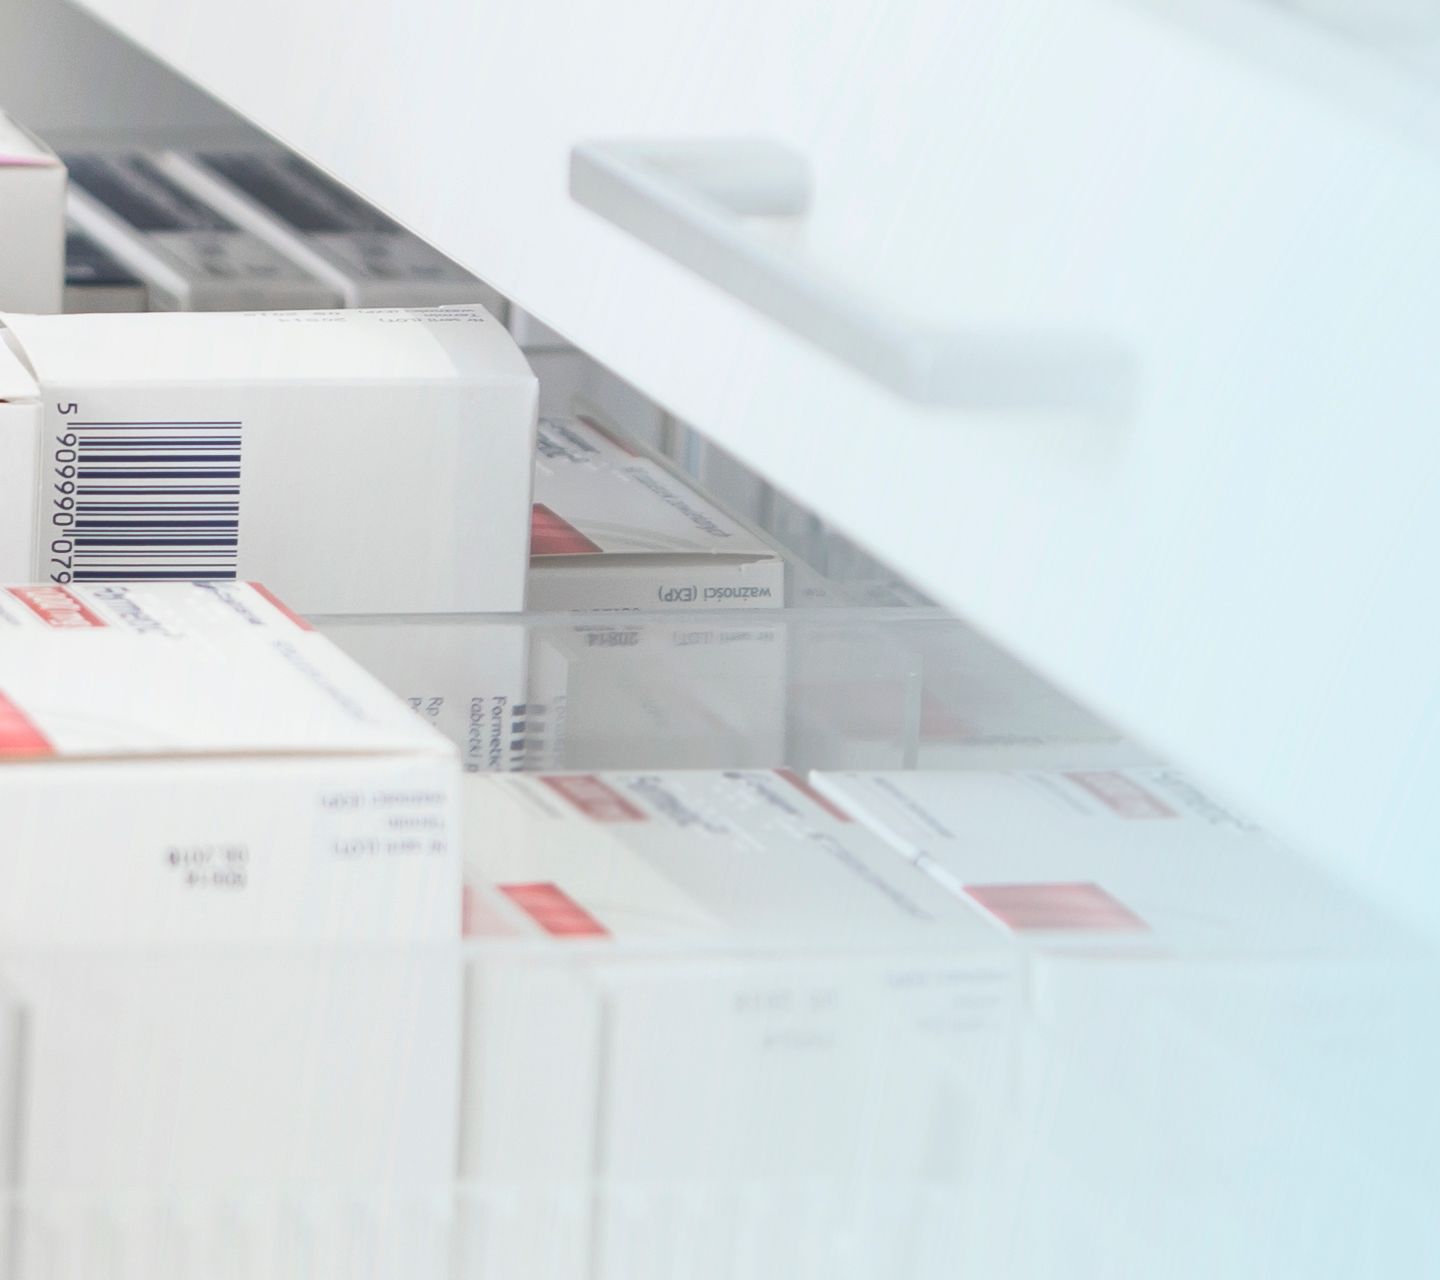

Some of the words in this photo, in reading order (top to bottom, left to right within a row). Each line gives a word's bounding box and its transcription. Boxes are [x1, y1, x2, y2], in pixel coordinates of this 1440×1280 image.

[57, 402, 77, 415] 5
[52, 433, 77, 526] 909990
[50, 540, 73, 585] 079
[657, 585, 698, 602] (EXP)
[703, 585, 771, 601] ważności
[469, 697, 485, 758] tabletki
